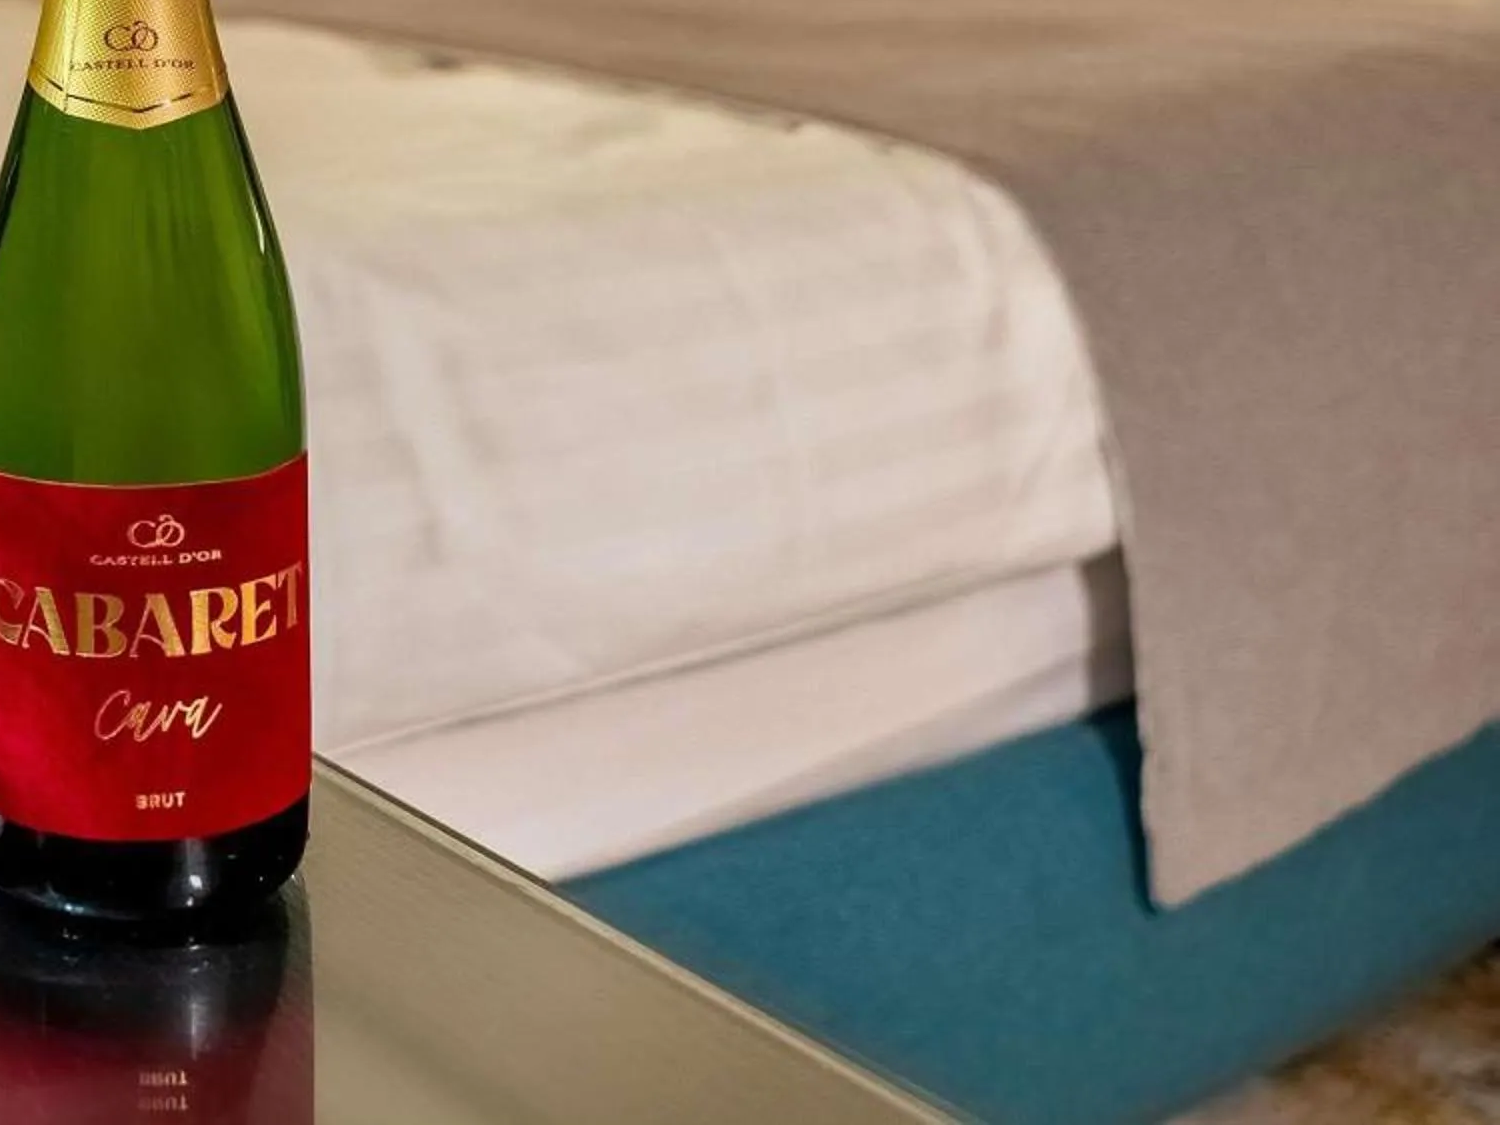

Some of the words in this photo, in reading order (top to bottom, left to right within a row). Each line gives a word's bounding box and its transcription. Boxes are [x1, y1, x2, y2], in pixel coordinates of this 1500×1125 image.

[89, 554, 173, 566] CASTELL
[179, 549, 222, 564] D'OR
[94, 689, 223, 742] Cava
[135, 791, 186, 810] BRUT
